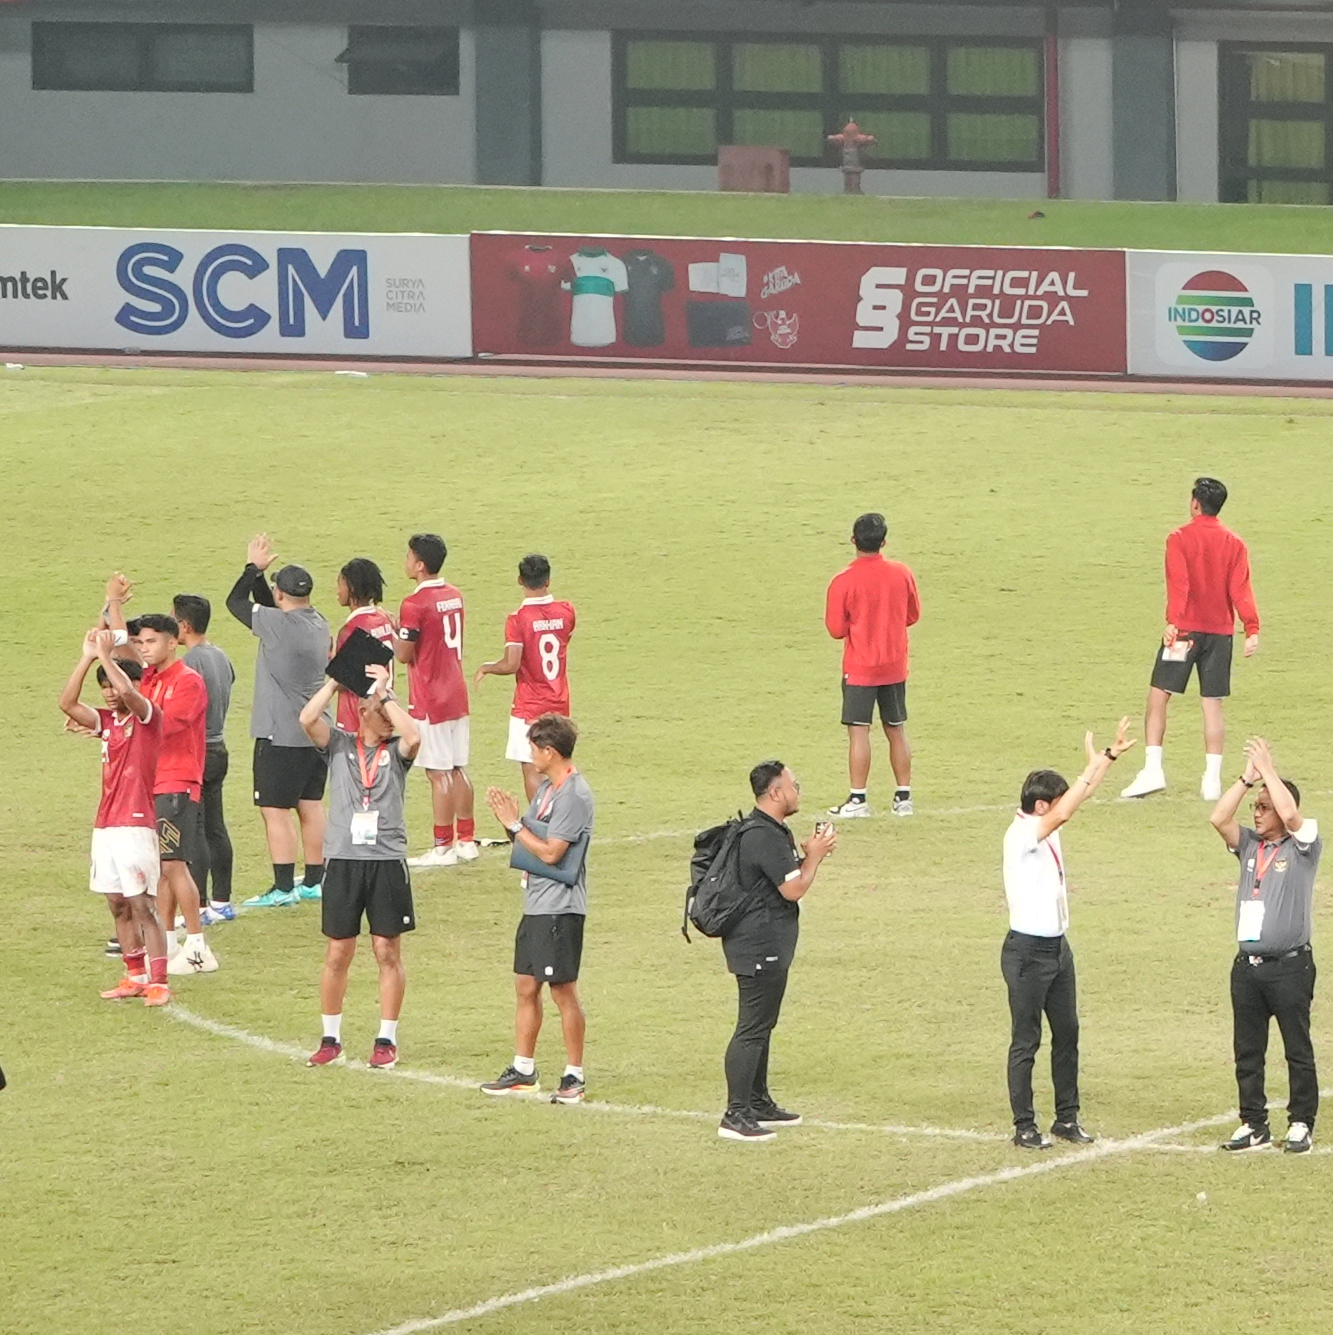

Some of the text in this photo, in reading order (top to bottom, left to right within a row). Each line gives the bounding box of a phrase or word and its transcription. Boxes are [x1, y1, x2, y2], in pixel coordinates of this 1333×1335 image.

[114, 241, 371, 340] SCM
[385, 277, 425, 289] SURYA
[386, 289, 426, 301] CITRA
[913, 267, 1090, 297] OFFICIAL
[386, 301, 427, 314] MEDIA
[909, 297, 1076, 326] GARUDA
[1167, 306, 1262, 326] INDOSIAR
[905, 325, 1041, 354] STORE
[399, 627, 410, 639] C
[442, 612, 462, 661] 4
[538, 633, 560, 681] 8
